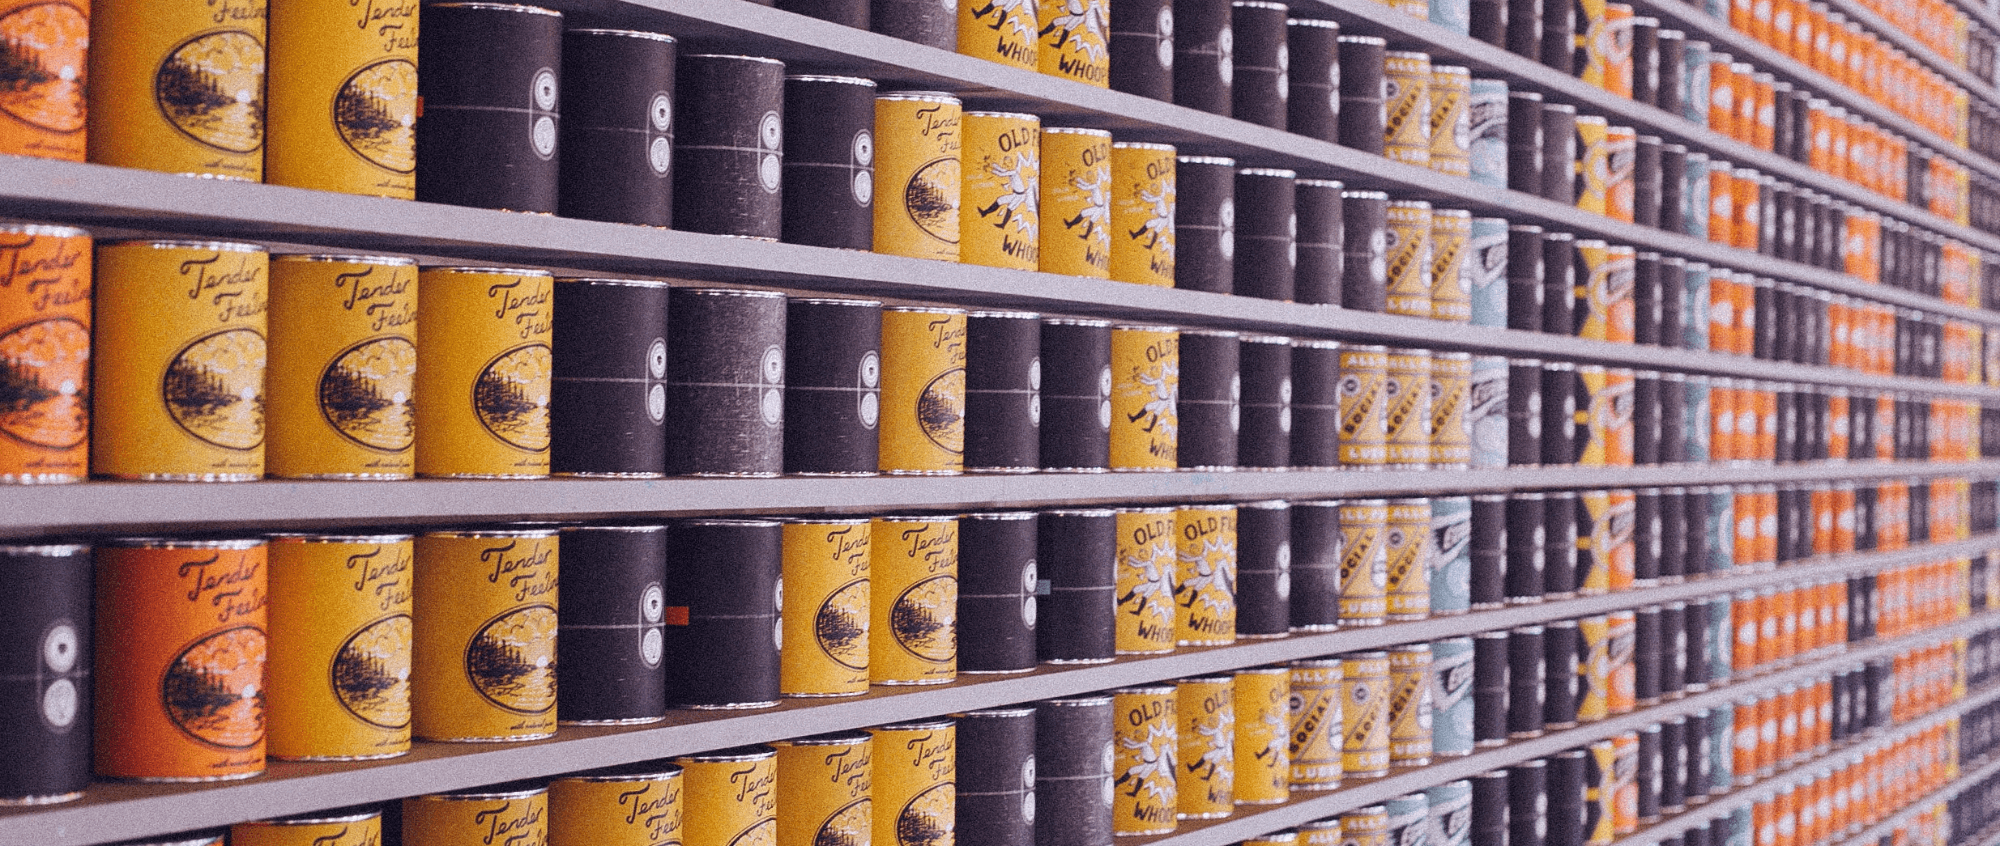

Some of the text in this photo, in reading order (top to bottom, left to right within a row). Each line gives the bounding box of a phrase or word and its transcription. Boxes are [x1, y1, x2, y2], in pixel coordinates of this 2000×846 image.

[998, 127, 1030, 153] OLD
[0, 235, 82, 288] Tender
[179, 253, 260, 300] Tender
[335, 266, 410, 311] Tender
[488, 278, 550, 319] Tender
[902, 523, 955, 558] Tender
[1133, 520, 1164, 545] OLD
[1184, 516, 1217, 541] OLD
[178, 552, 258, 602] Tender
[347, 546, 410, 591] Tender
[480, 540, 552, 583] Tender
[1293, 673, 1322, 683] ALL
[1129, 700, 1162, 726] OLD
[1289, 696, 1331, 754] SOCIAL
[907, 732, 954, 766] Tender
[475, 801, 543, 845] Tender
[619, 783, 679, 824] Tender
